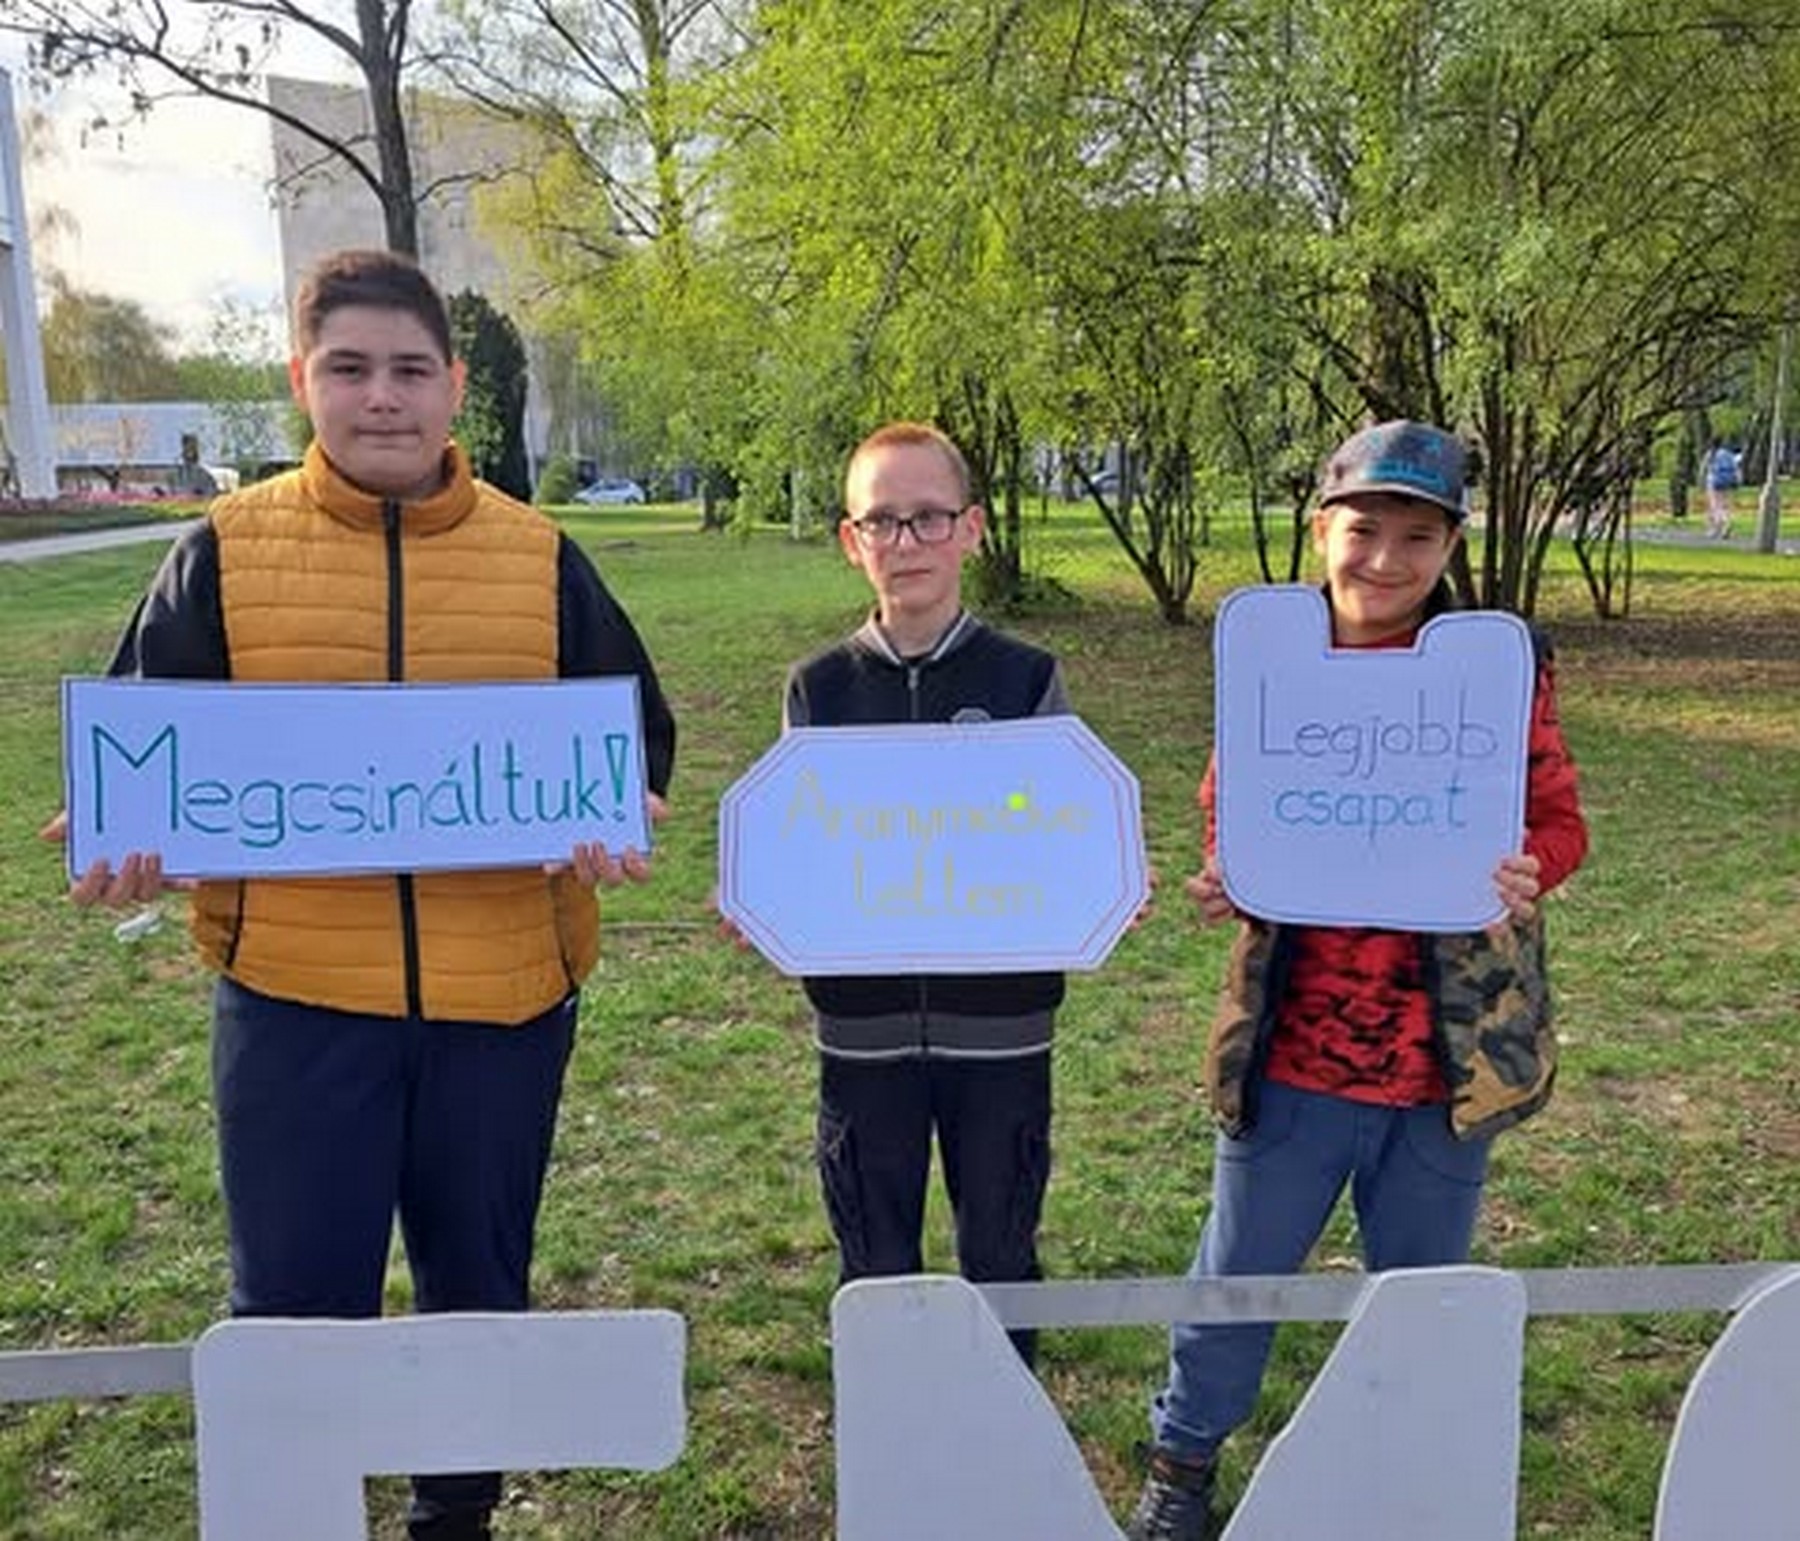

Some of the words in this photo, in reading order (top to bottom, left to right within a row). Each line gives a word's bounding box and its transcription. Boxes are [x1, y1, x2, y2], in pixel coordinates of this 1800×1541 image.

[1259, 674, 1498, 780] Legjobb
[90, 722, 630, 848] Megcsináltuk!
[1274, 769, 1467, 842] csapat
